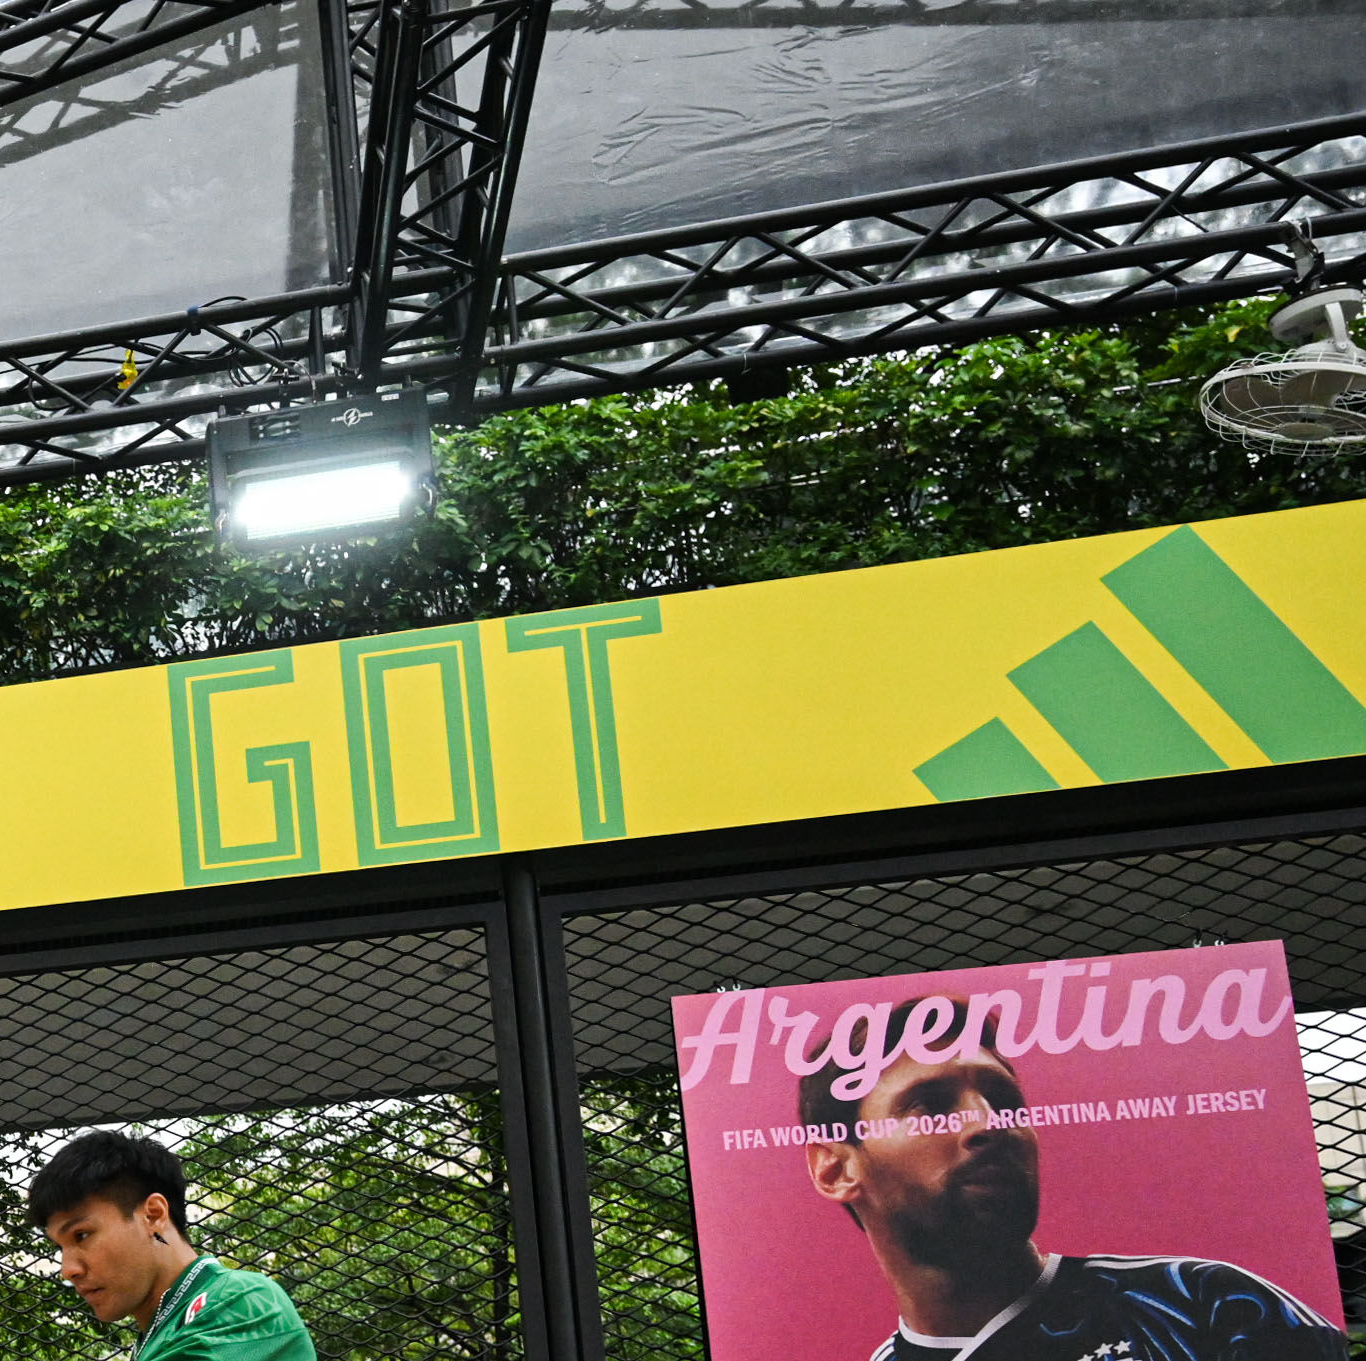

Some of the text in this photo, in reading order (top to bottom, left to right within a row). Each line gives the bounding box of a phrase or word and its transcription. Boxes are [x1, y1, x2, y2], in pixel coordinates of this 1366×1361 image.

[167, 597, 662, 887] GOT
[679, 959, 1294, 1102] Argentina
[723, 1128, 767, 1150] FIFA
[769, 1123, 848, 1147] WORLD
[854, 1118, 900, 1140] CUP
[986, 1101, 1111, 1130] ARGENTINA
[1115, 1095, 1177, 1121] AWAY
[1186, 1088, 1267, 1116] JERSEY
